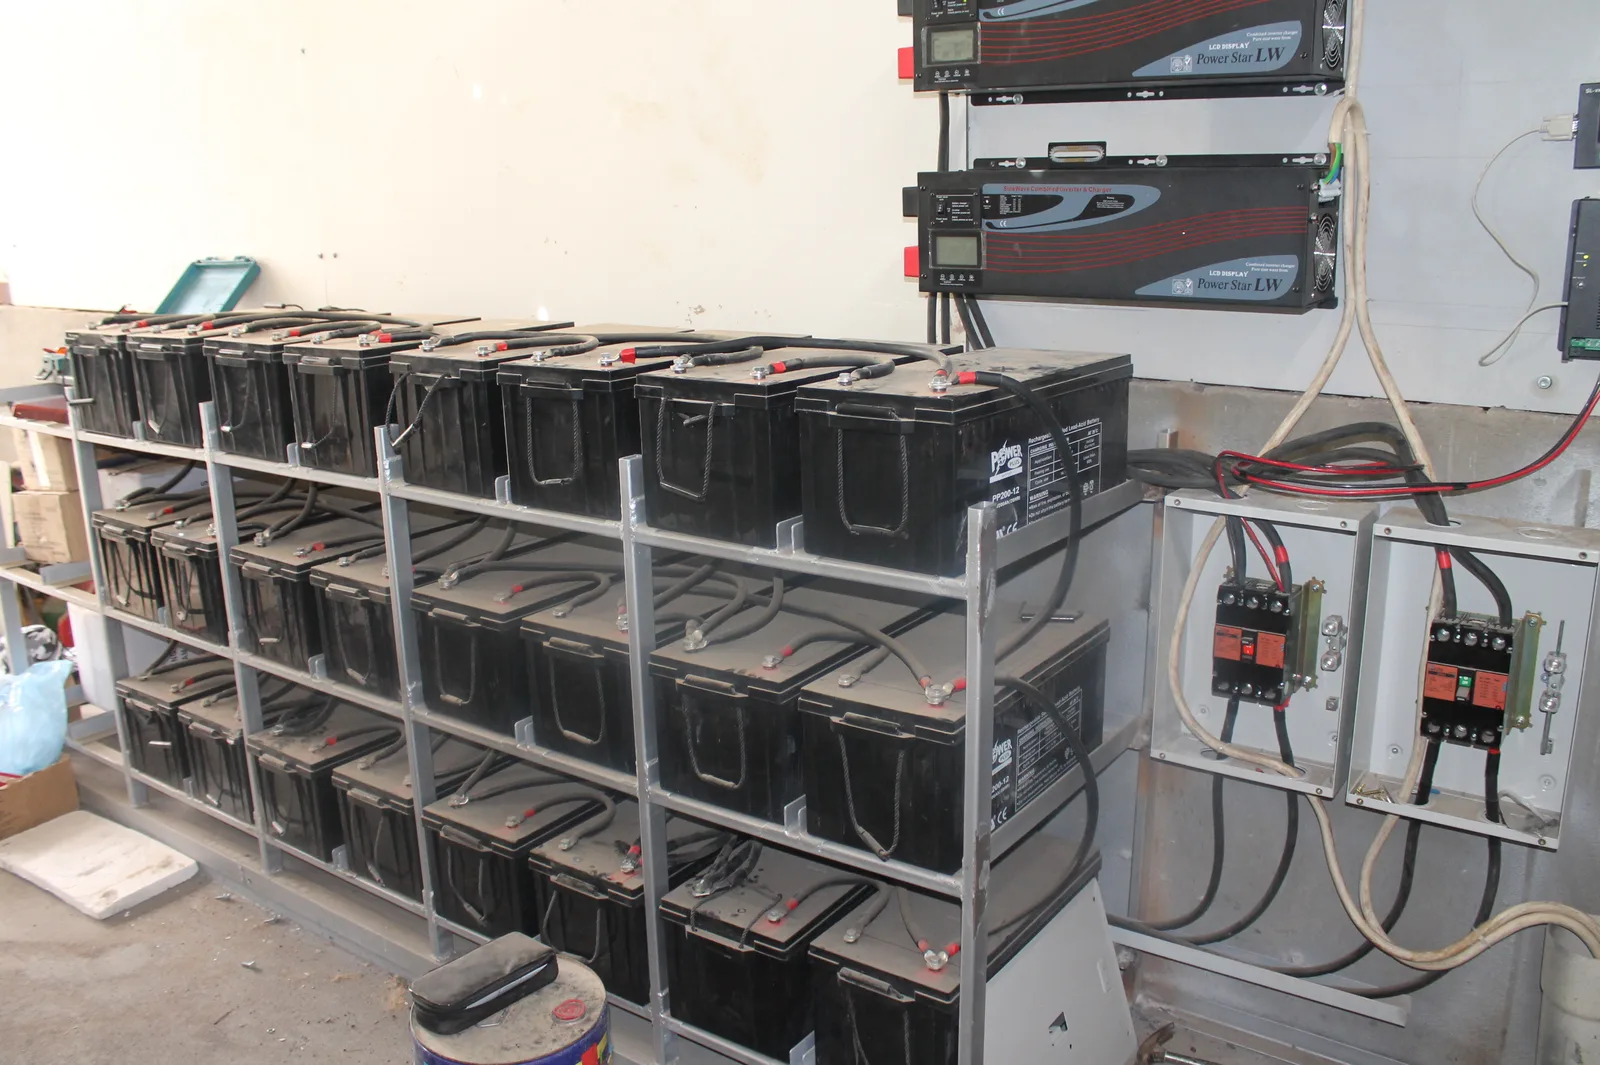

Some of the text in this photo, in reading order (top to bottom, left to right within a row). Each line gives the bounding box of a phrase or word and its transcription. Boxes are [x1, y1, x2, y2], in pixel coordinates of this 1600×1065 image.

[1209, 42, 1250, 51] LCD DISPLAY
[1196, 47, 1286, 65] Power Star LW
[1197, 277, 1283, 292] Power Star LW
[991, 444, 1023, 473] POWER
[992, 486, 1020, 503] PP200-12
